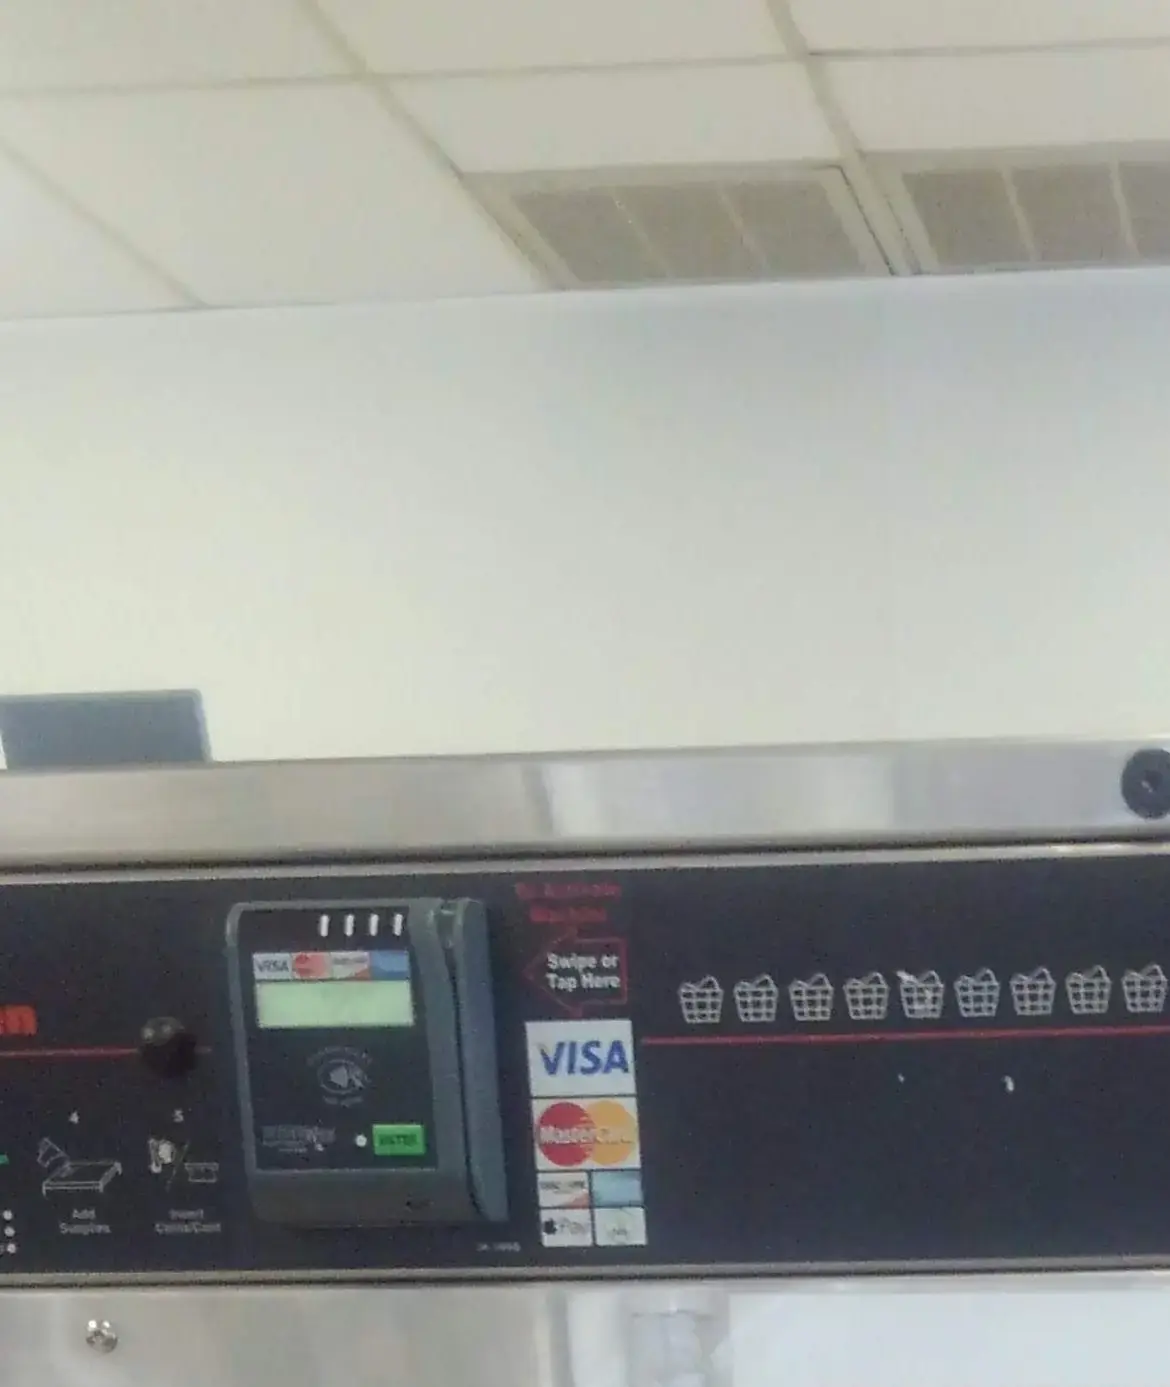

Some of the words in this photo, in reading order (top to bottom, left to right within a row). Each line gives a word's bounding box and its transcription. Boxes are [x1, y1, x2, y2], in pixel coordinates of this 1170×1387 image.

[547, 953, 598, 973] Swipe
[601, 954, 619, 967] or
[545, 973, 578, 992] Tap
[579, 973, 621, 989] Here
[538, 1040, 629, 1076] VISA
